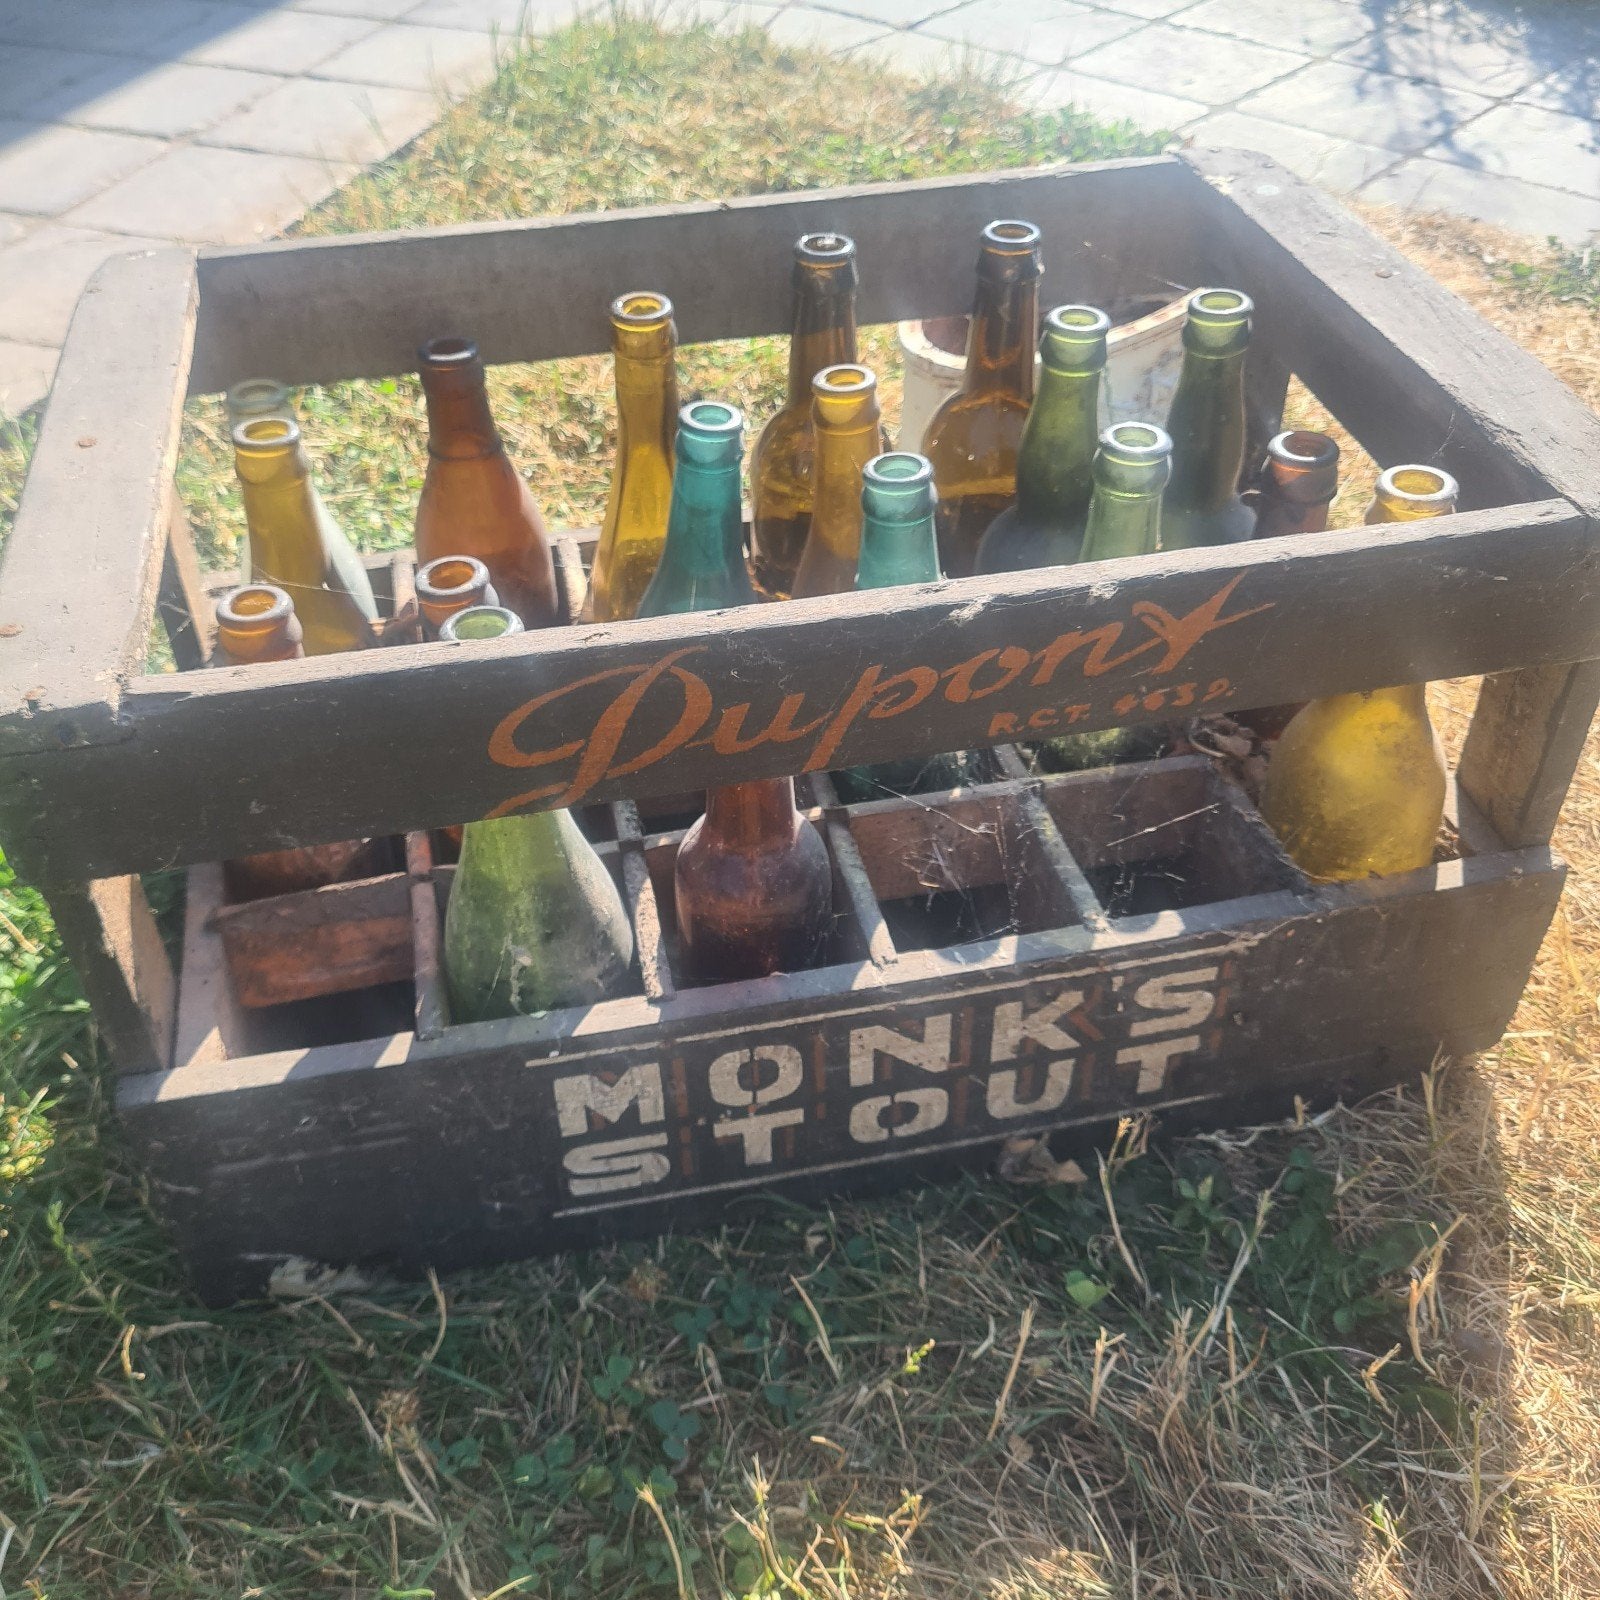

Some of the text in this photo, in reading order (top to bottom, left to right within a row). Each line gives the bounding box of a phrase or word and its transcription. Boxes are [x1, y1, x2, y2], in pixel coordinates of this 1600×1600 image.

[488, 571, 1276, 817] Dupont
[552, 966, 1220, 1139] MONK'S
[561, 1034, 1202, 1197] STOUT
